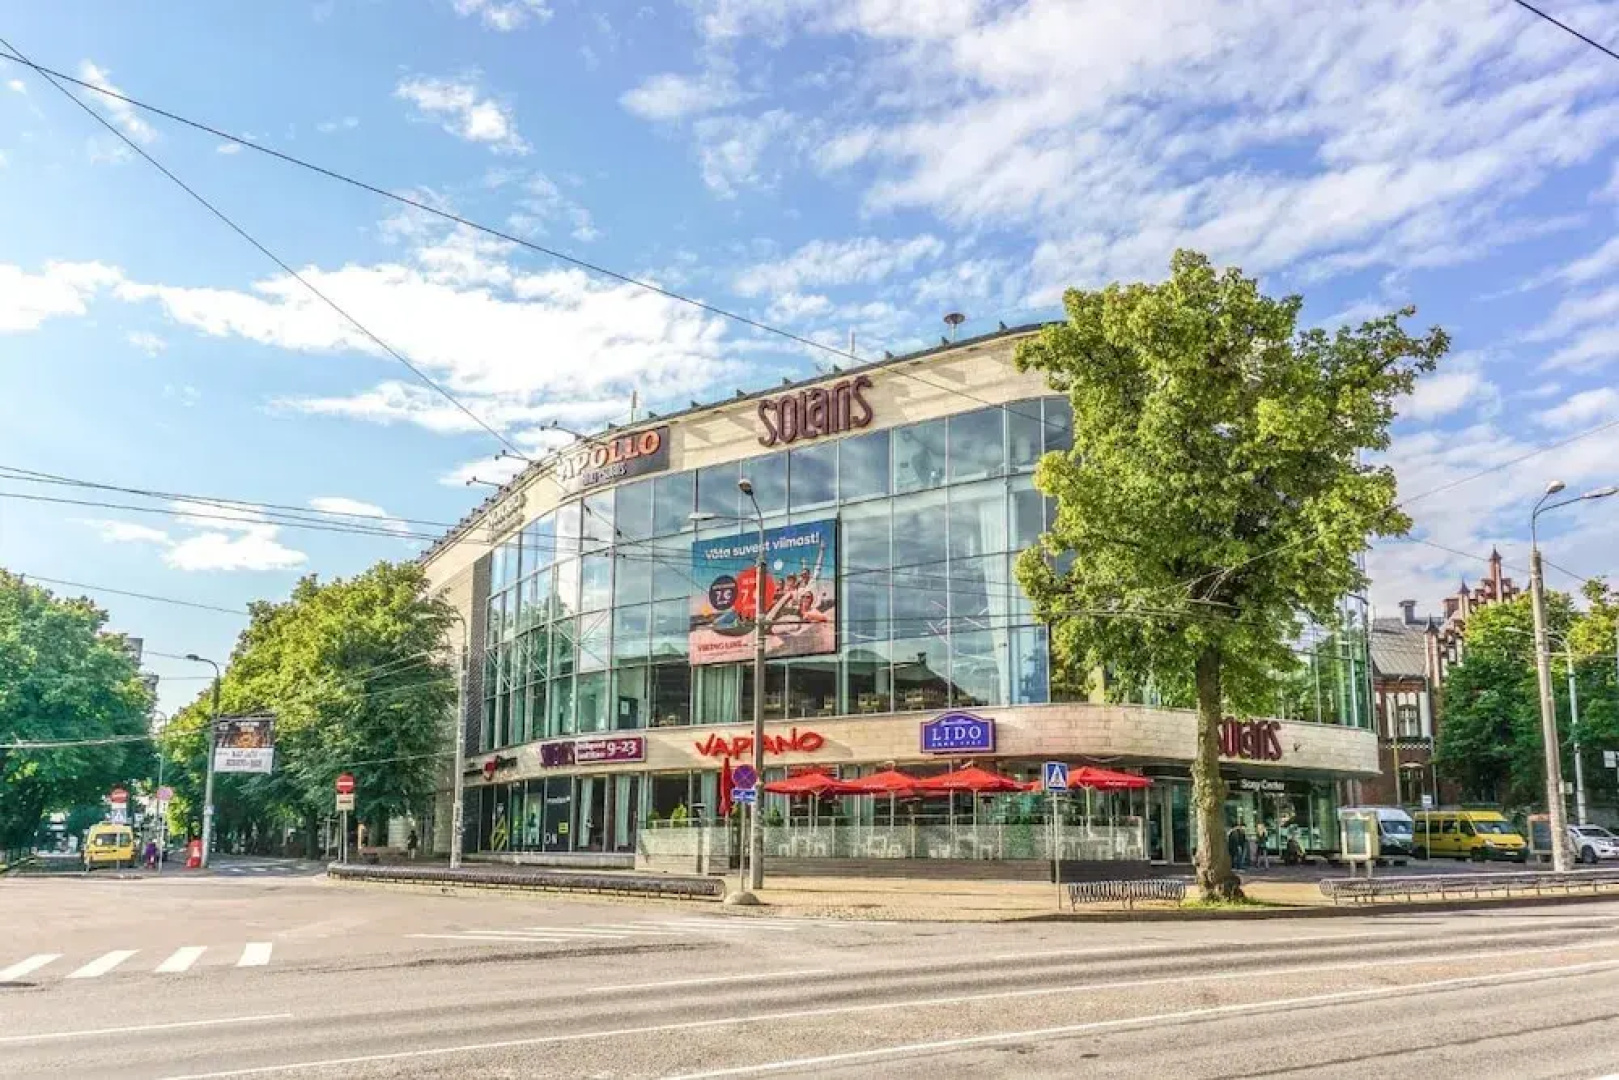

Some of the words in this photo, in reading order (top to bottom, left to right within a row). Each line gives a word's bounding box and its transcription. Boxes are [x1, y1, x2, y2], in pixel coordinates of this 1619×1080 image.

[558, 430, 661, 481] APOLLO
[695, 726, 825, 760] VAPIANO
[931, 725, 982, 742] LIDO
[606, 741, 637, 757] 9-23
